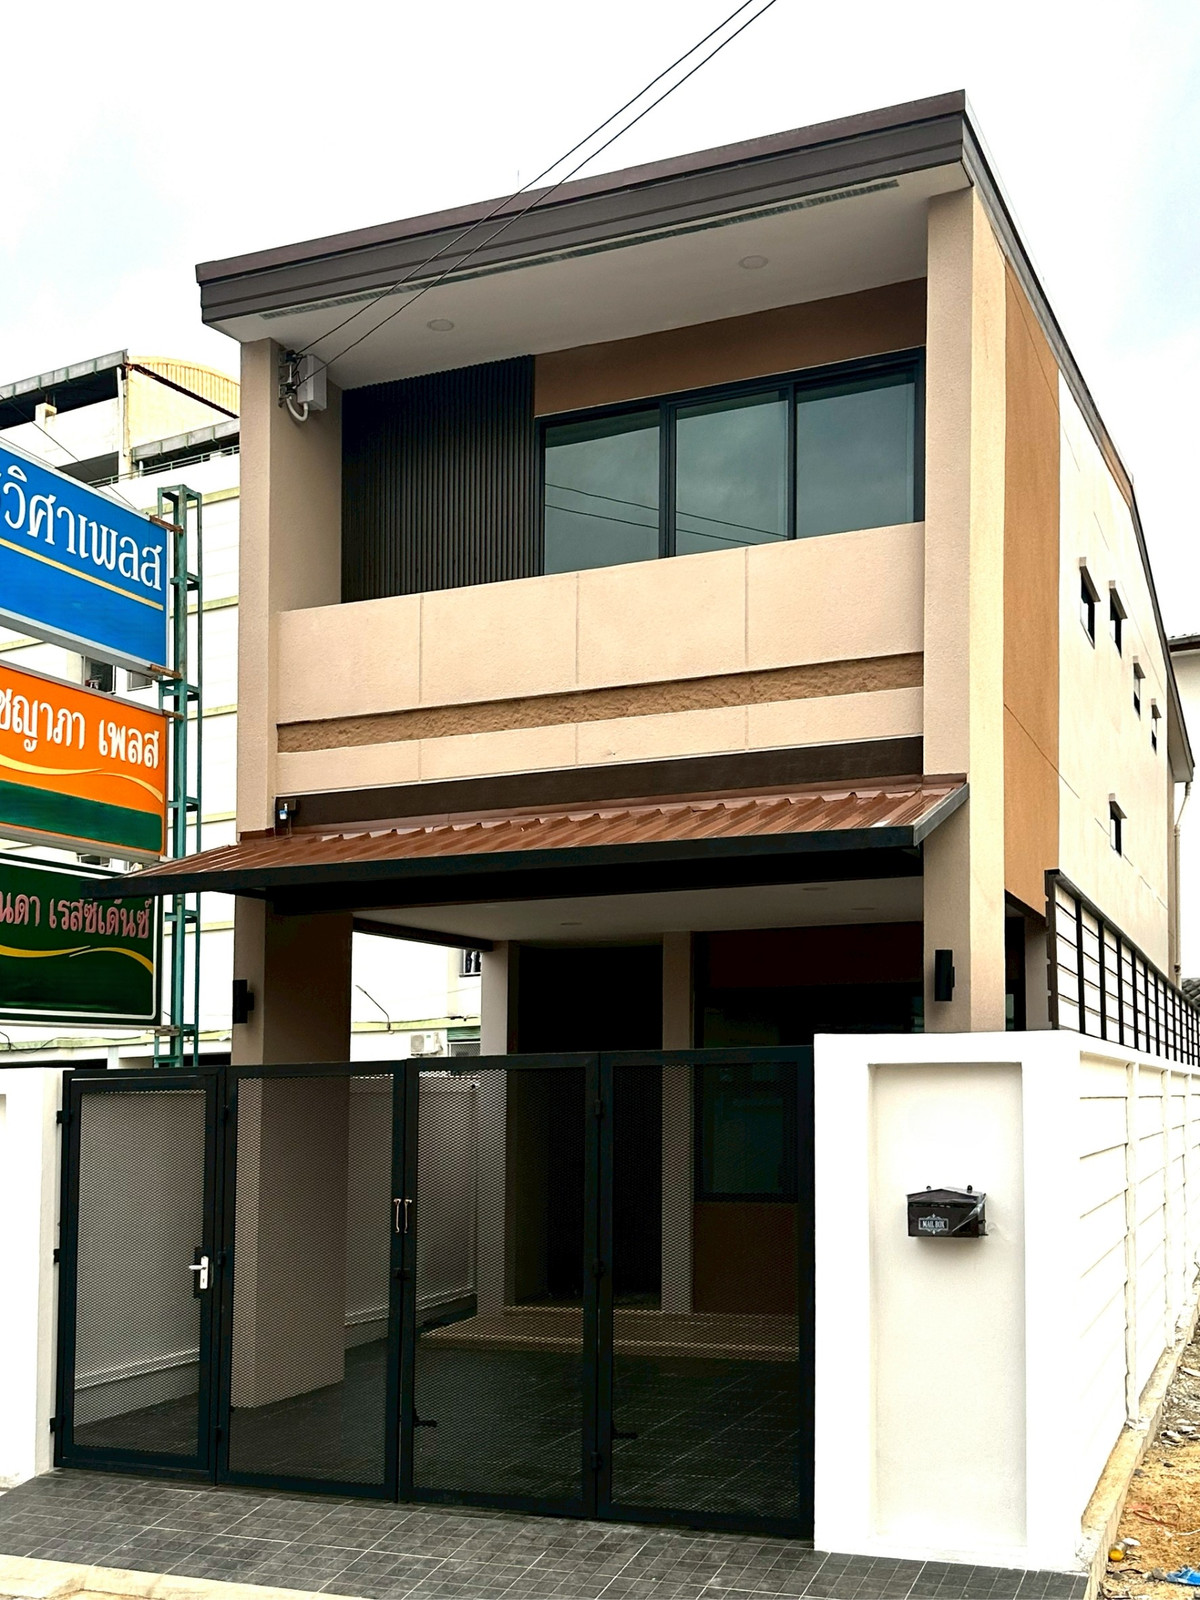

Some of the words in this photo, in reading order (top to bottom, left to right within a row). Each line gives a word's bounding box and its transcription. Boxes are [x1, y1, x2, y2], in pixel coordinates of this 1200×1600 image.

[0, 465, 163, 591] วิศาเพลส
[98, 719, 160, 769] เพลส
[922, 1220, 934, 1228] MAIL
[935, 1221, 945, 1229] BOX
